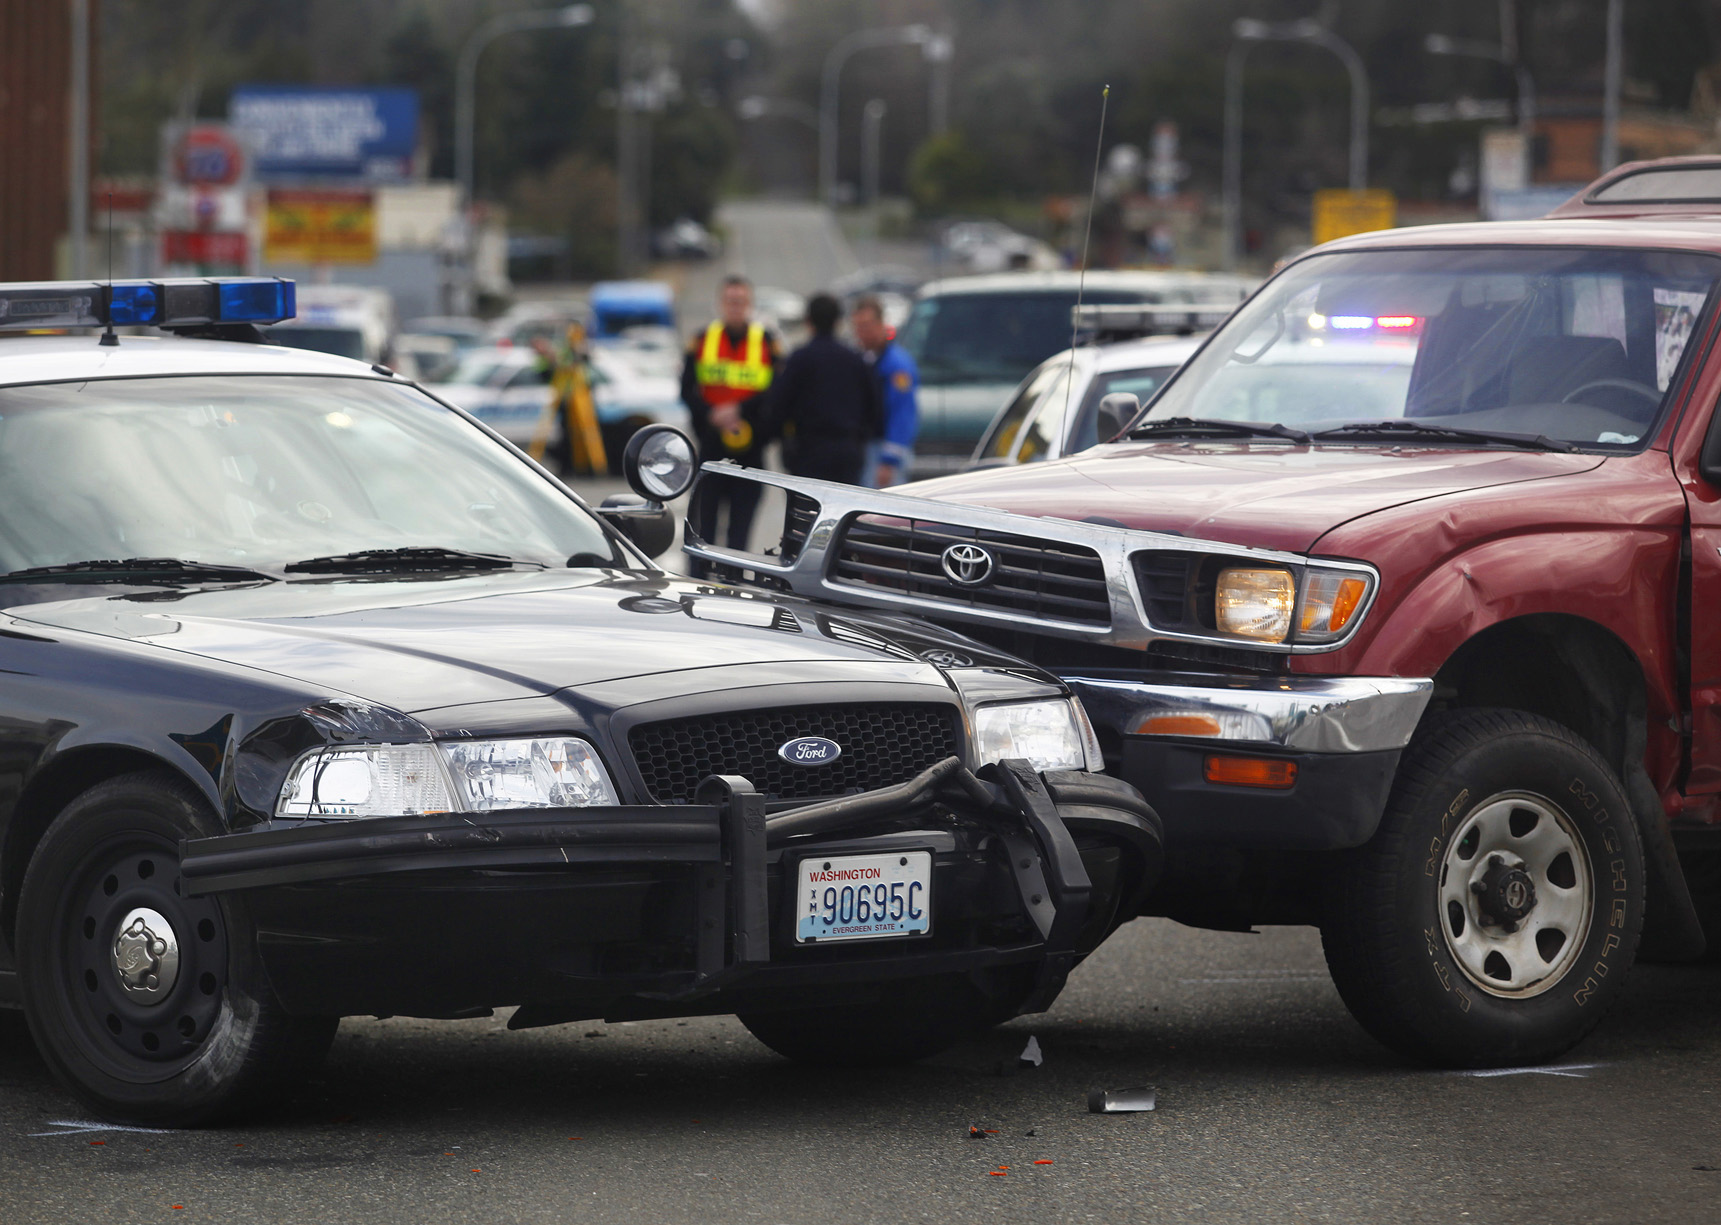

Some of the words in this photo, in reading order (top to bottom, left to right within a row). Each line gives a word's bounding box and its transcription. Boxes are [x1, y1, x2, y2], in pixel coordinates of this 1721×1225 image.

[796, 743, 827, 759] Ford
[809, 868, 881, 882] WASHINGTON
[1568, 777, 1627, 1007] MICHELIN
[823, 881, 923, 925] 90695C
[832, 924, 872, 934] EVERGREEN
[875, 923, 895, 931] STATE
